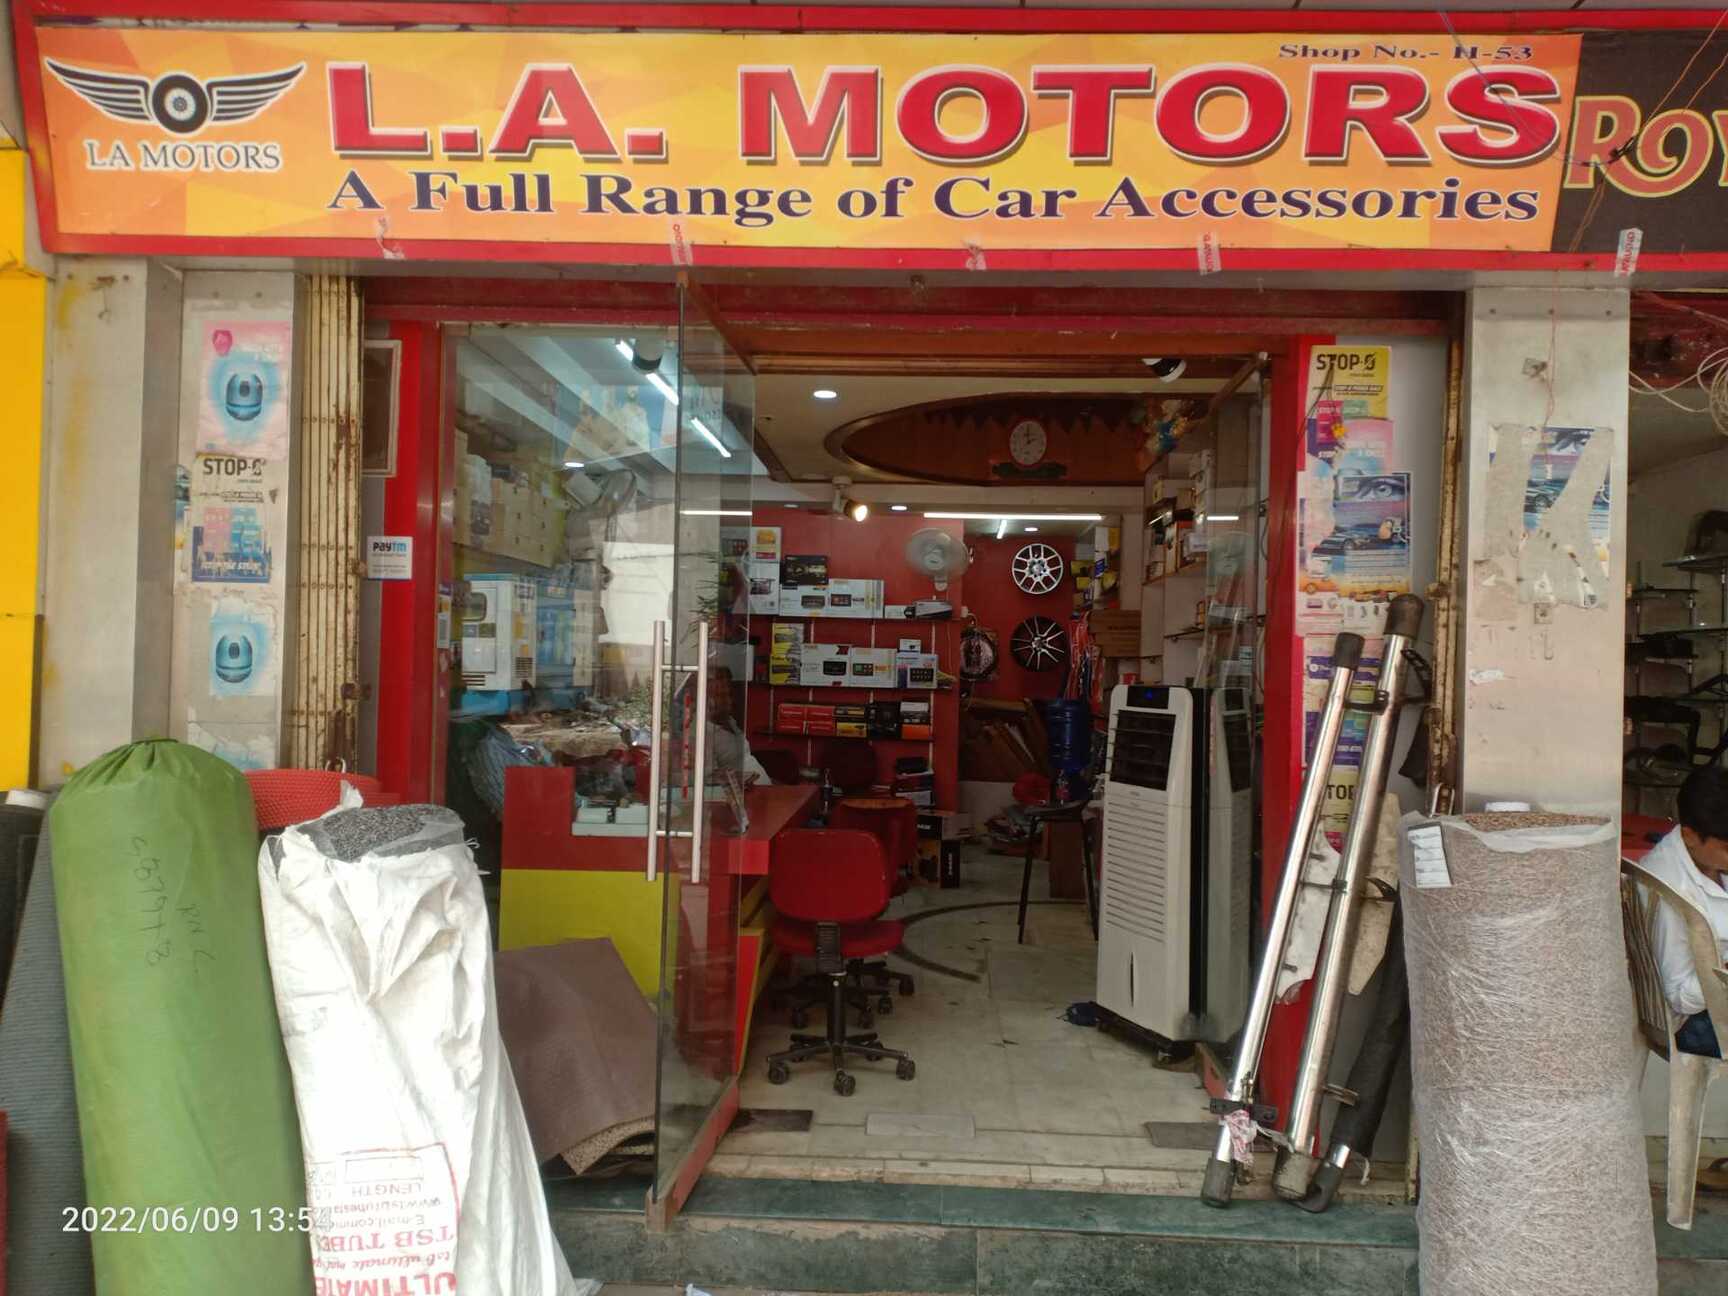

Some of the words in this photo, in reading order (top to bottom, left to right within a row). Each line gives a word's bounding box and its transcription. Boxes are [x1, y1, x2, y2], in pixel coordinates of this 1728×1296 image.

[1279, 43, 1361, 61] Shop
[326, 62, 667, 161] L.A.
[738, 62, 1560, 165] MOTORS
[85, 140, 132, 170] LA
[140, 141, 281, 171] MOTORS
[328, 169, 384, 211] A
[408, 170, 556, 213] Full
[580, 172, 813, 228] Range
[837, 176, 914, 219] of
[933, 176, 1077, 219] Car
[1095, 175, 1540, 221] Accessories
[351, 1183, 422, 1198] LENGTH
[394, 1225, 454, 1248] TSB
